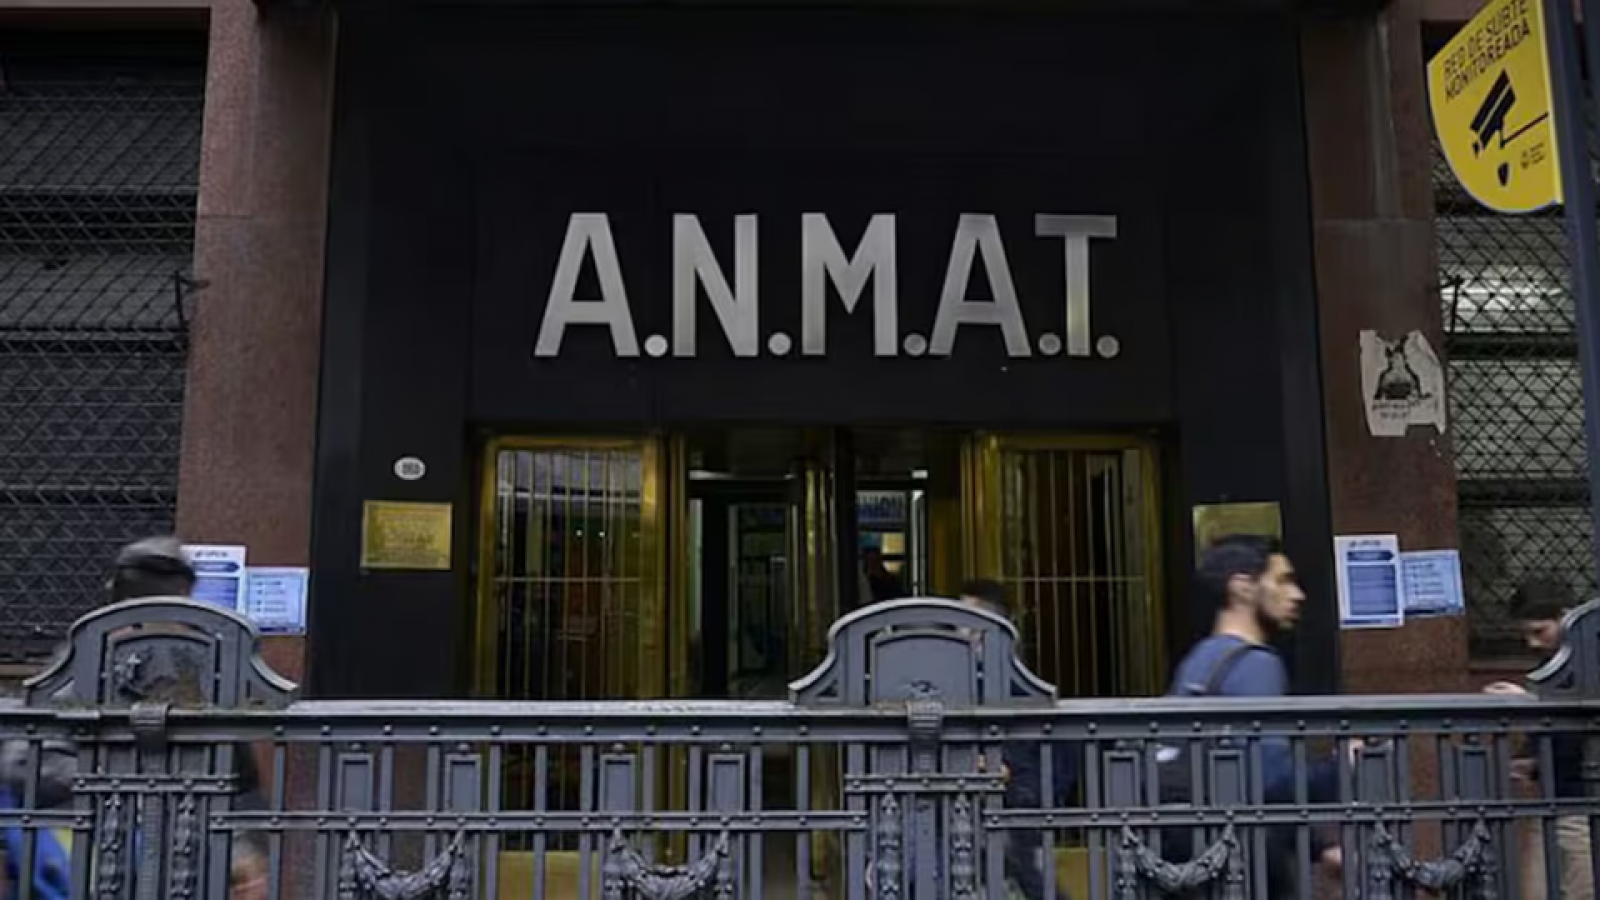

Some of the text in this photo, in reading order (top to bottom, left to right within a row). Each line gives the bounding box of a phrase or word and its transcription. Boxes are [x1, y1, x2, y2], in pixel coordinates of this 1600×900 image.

[1444, 0, 1527, 80] RED DE SUBTE
[1444, 17, 1530, 103] MONITOREADA
[534, 212, 1120, 358] A.N.M.A.T.
